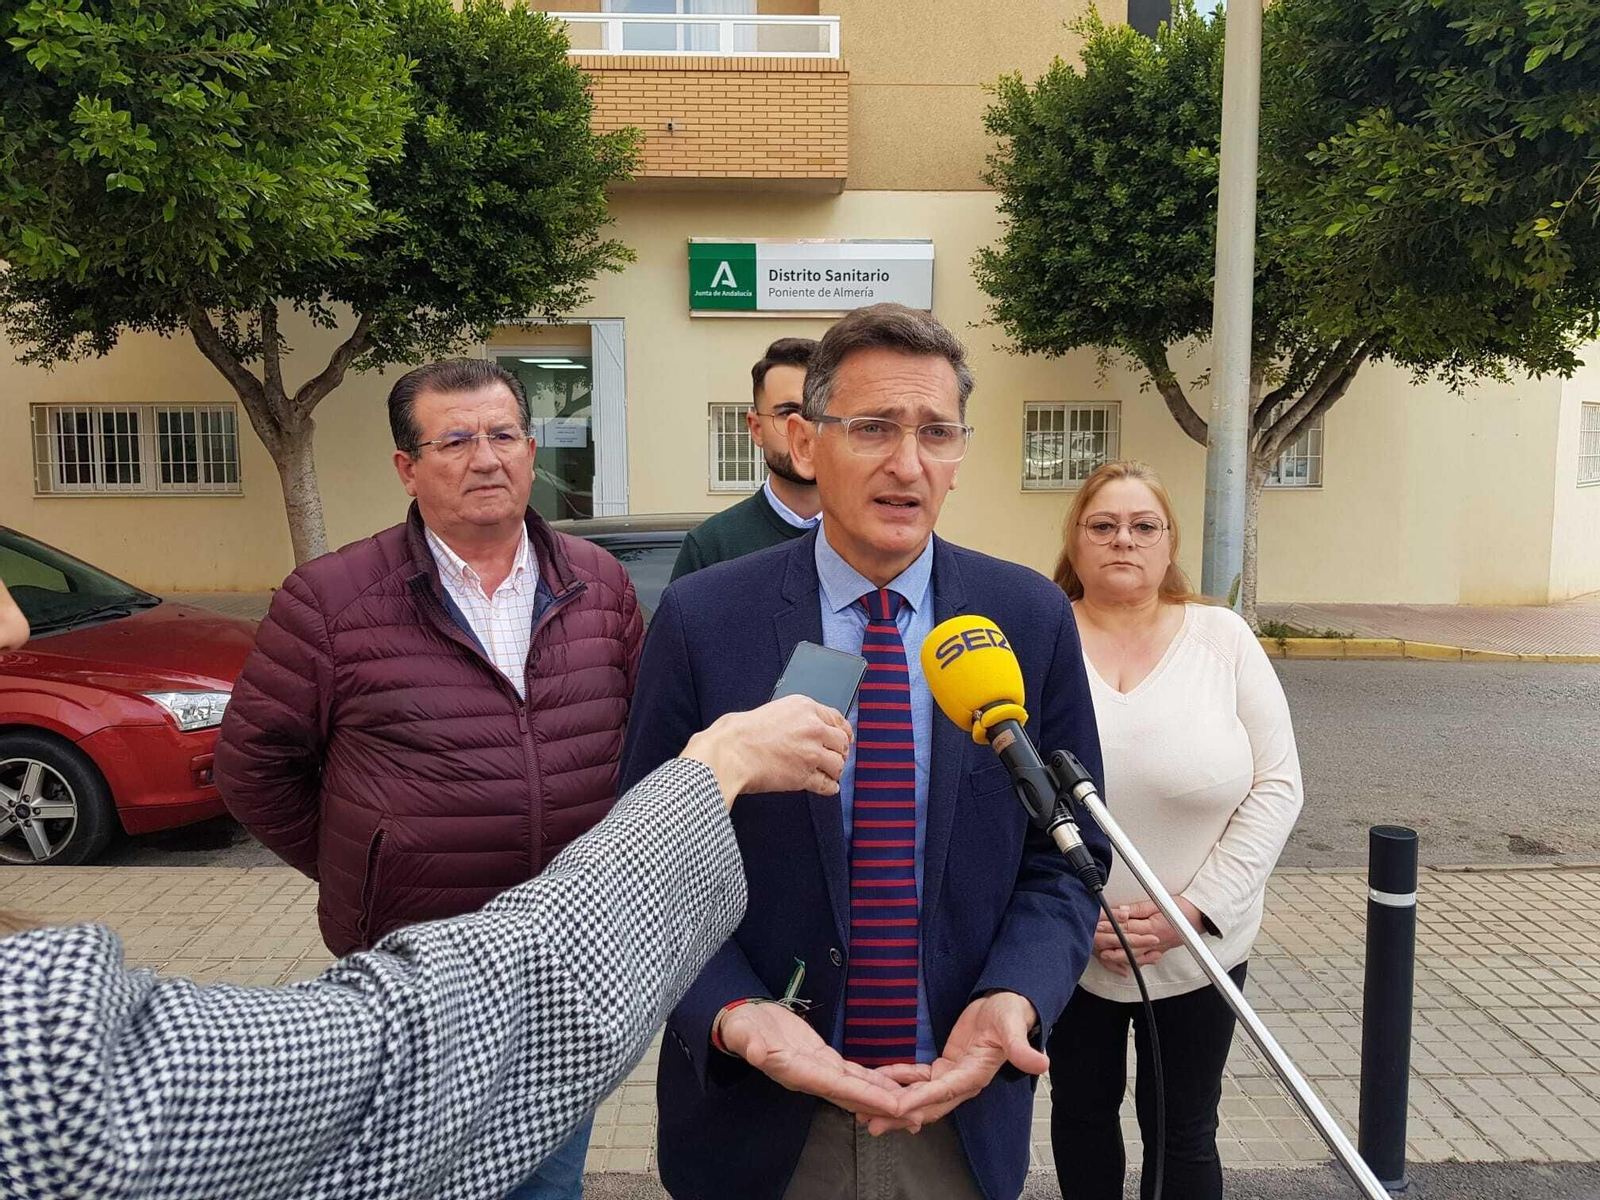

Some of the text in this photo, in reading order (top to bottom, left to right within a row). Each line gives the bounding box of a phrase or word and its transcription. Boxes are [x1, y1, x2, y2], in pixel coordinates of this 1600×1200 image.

[768, 268, 890, 282] Distrito Sanitario
[768, 286, 874, 298] Poniente de Almería
[935, 628, 1012, 670] SER
